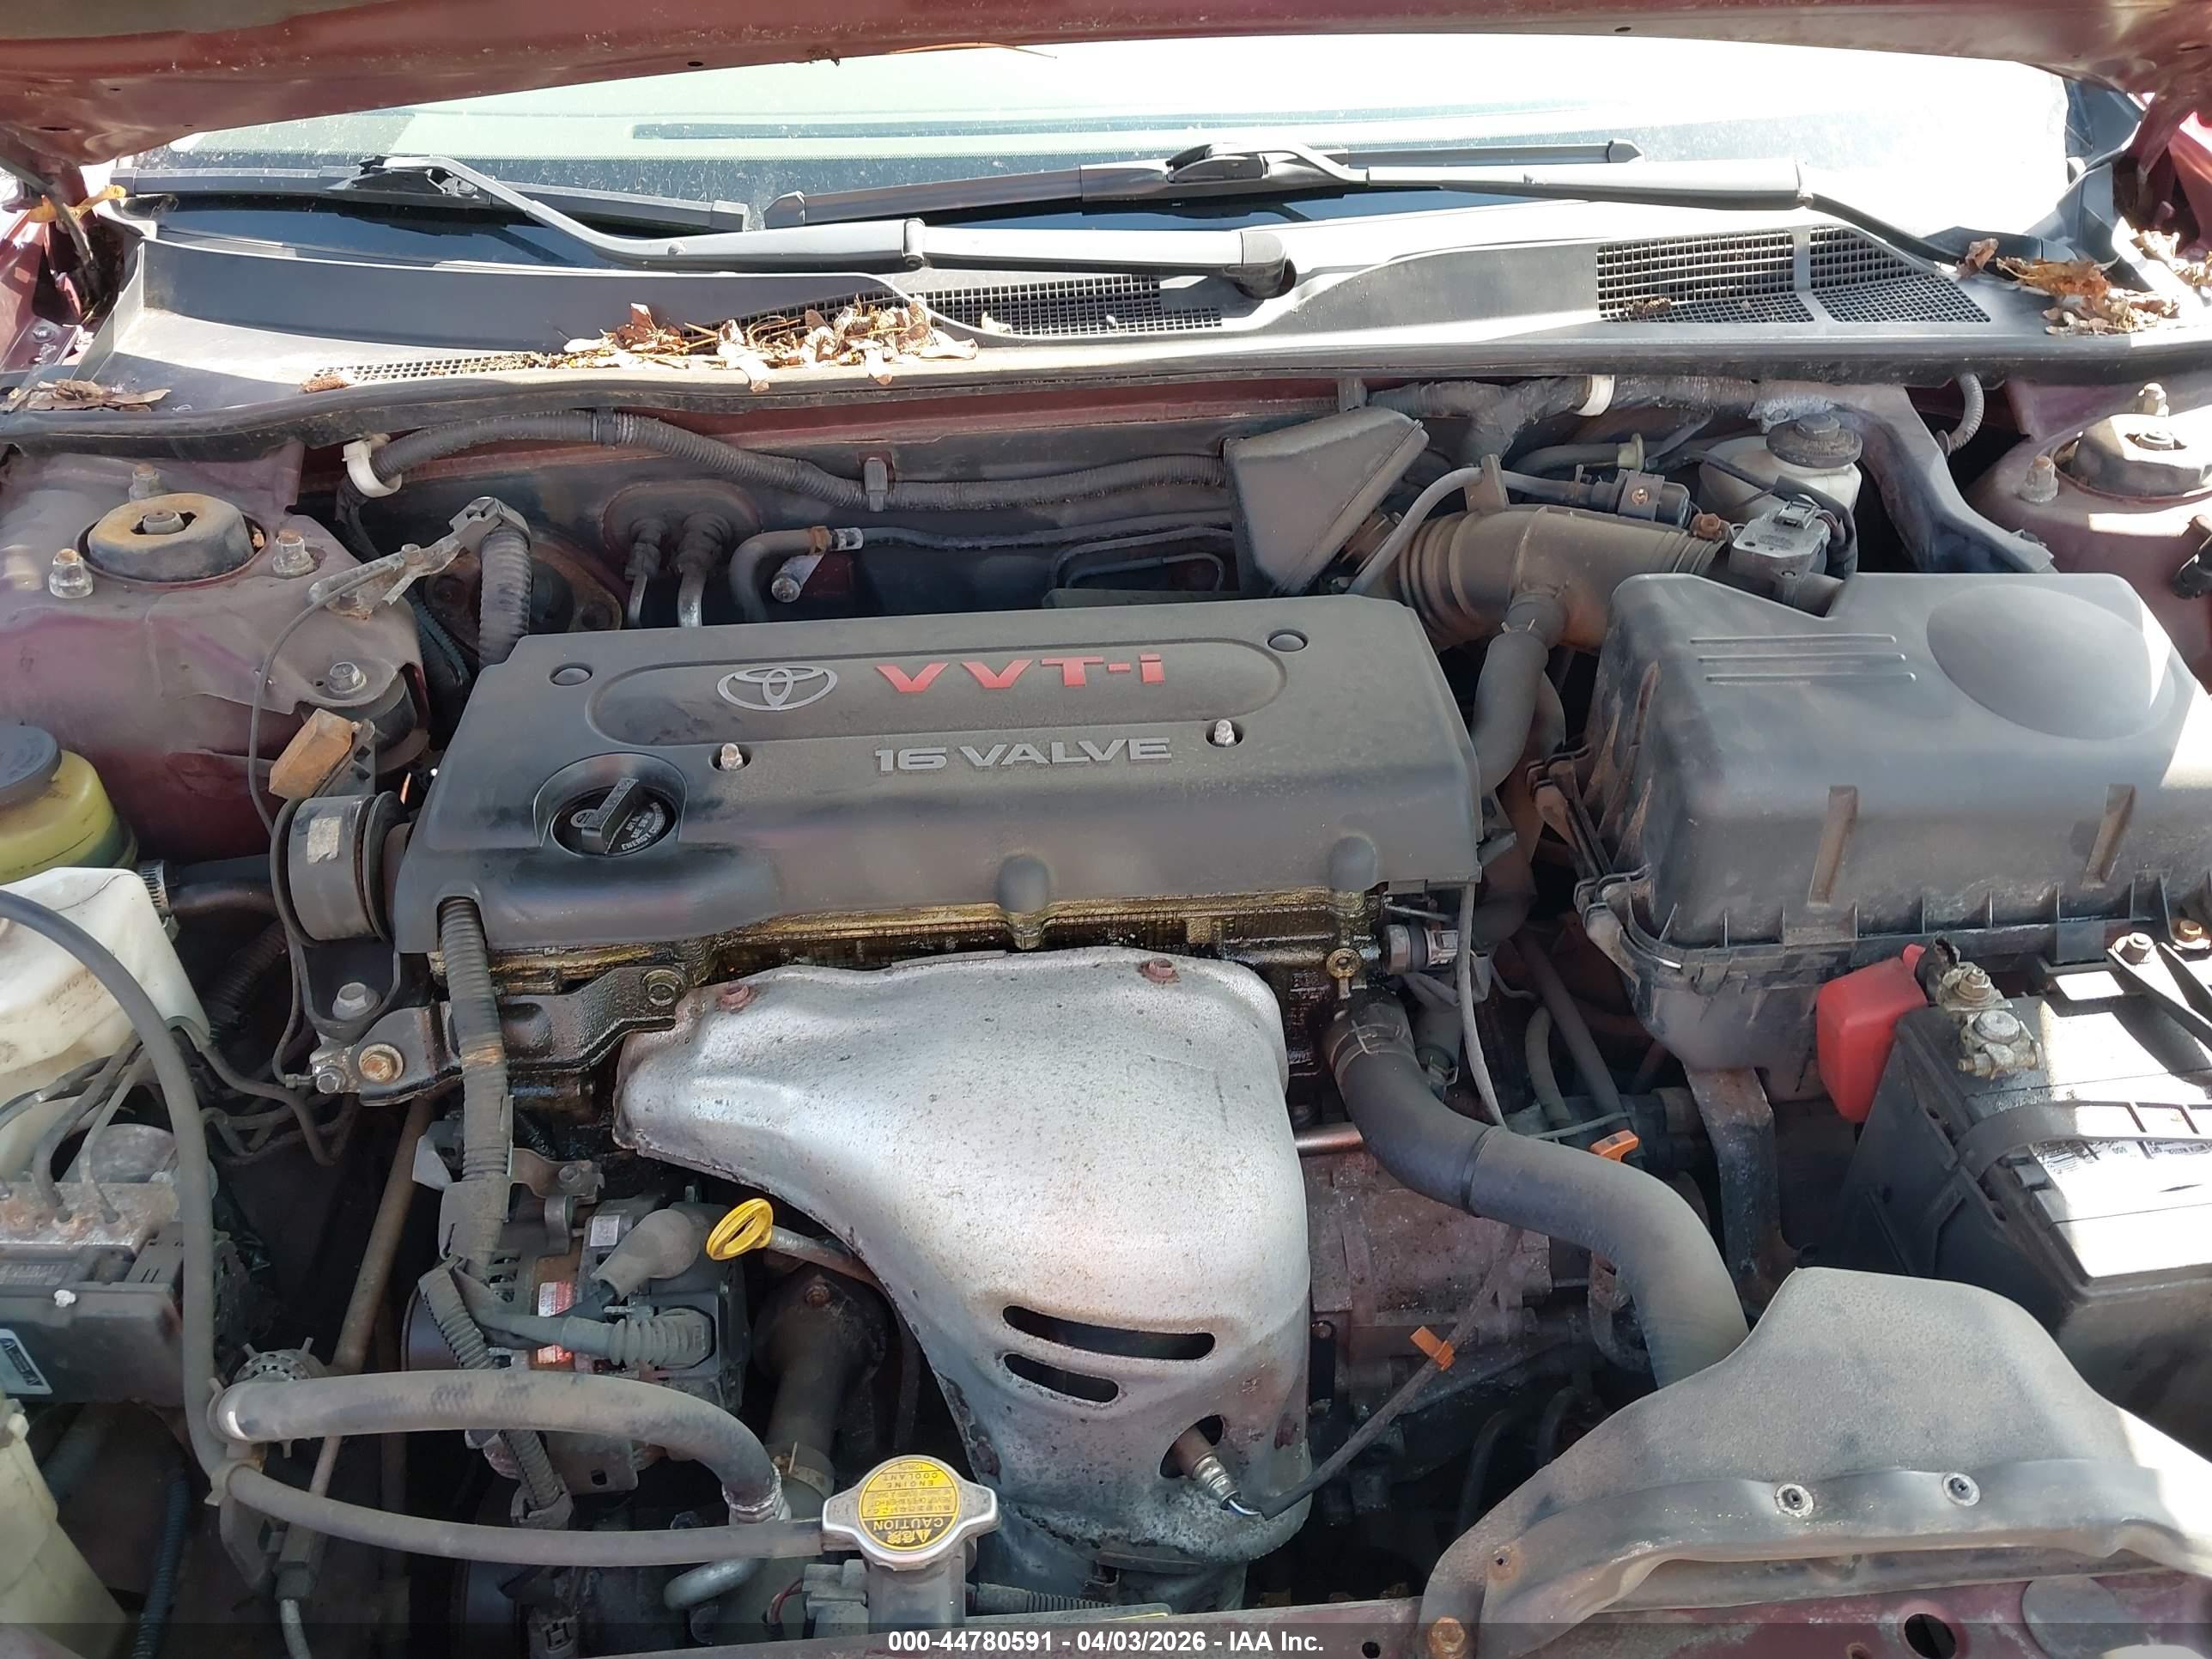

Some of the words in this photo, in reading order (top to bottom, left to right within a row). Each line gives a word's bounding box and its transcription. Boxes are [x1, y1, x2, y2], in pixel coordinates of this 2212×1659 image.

[876, 653, 1165, 693] VVT-i
[875, 747, 947, 772] 16
[959, 737, 1172, 768] VALVE
[621, 833, 651, 850] ENERGY
[884, 1472, 939, 1481] COOLANT
[886, 1480, 934, 1488] ENGINE
[873, 1517, 944, 1531] CAUTION
